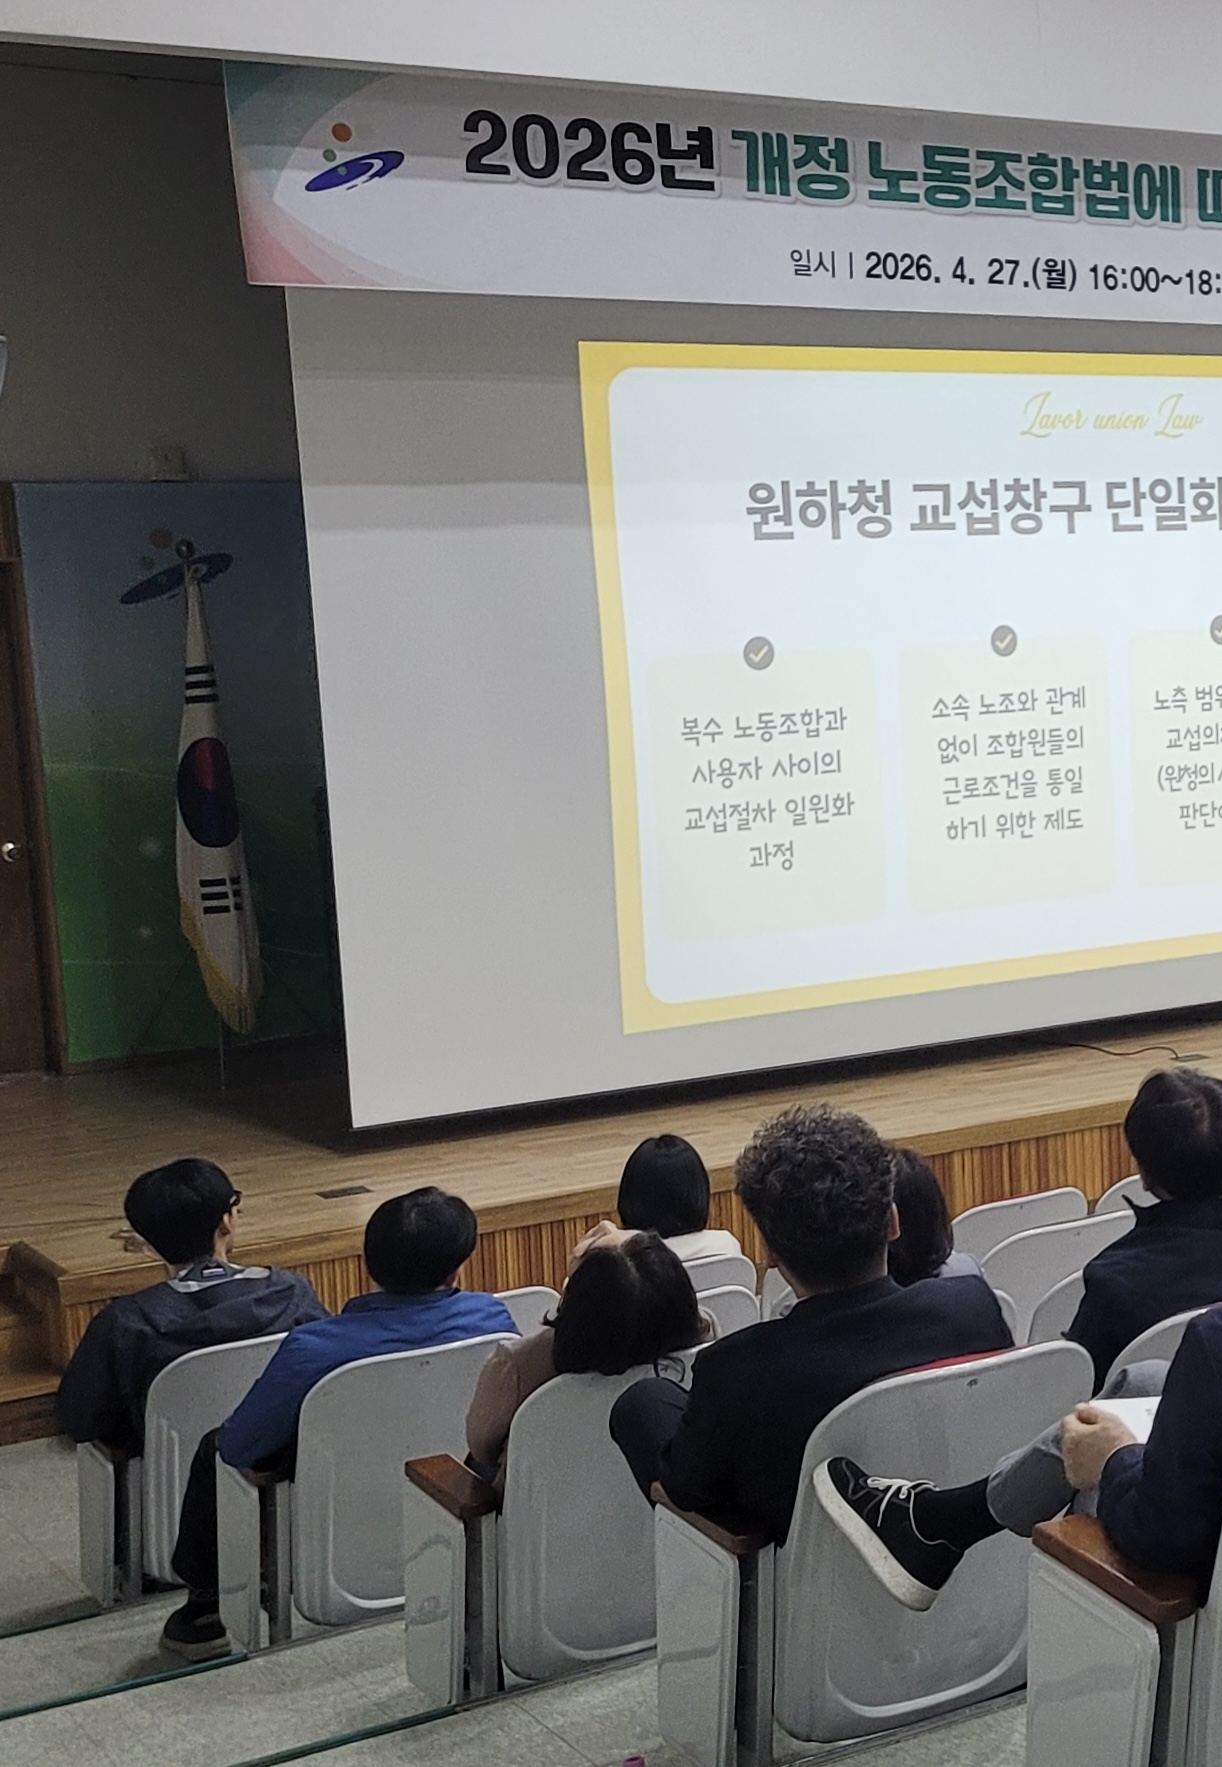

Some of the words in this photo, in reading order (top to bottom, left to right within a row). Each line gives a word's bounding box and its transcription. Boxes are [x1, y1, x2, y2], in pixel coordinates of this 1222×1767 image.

[464, 110, 715, 193] 2026년
[731, 130, 850, 200] 개정
[868, 141, 1181, 223] 노동조합법에
[791, 249, 835, 278] 일시
[1020, 391, 1084, 438] Lavor
[1093, 410, 1149, 432] union
[1154, 393, 1203, 438] Law
[746, 479, 892, 540] 원하청
[910, 478, 1092, 536] 교섭창구
[932, 694, 970, 721] 소속
[979, 689, 1038, 715] 노조와
[1046, 686, 1085, 715] 관계
[1154, 686, 1188, 713] 노측
[681, 717, 723, 746] 복수
[734, 707, 847, 742] 노동조합과
[938, 734, 977, 764] 없이
[987, 726, 1083, 758] 조합원들의
[692, 756, 763, 789] 사용자
[772, 750, 841, 777] 사이의
[943, 770, 1037, 805] 근로조건을
[1046, 766, 1083, 796] 통일
[685, 799, 776, 833] 교섭절차
[785, 792, 855, 826] 일원화
[946, 815, 986, 840] 하기
[996, 811, 1036, 838] 위한
[1044, 808, 1083, 830] 제도
[750, 840, 793, 871] 과정
